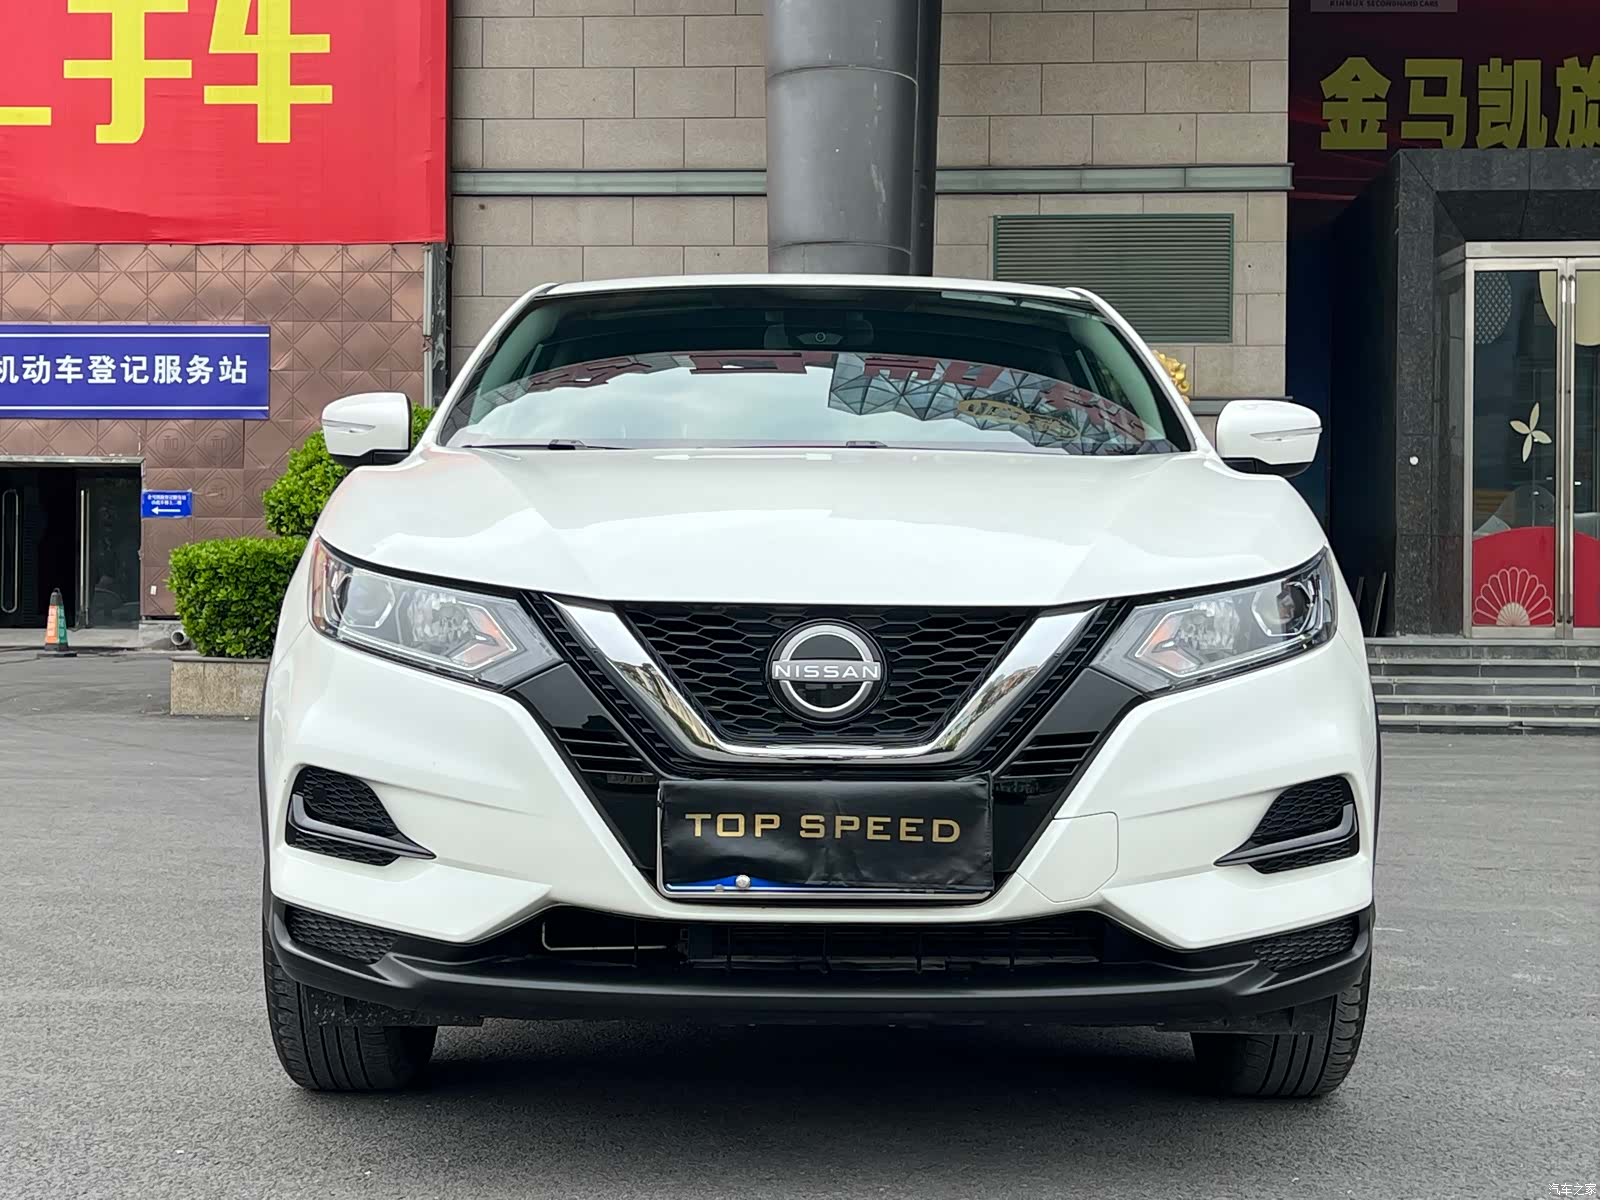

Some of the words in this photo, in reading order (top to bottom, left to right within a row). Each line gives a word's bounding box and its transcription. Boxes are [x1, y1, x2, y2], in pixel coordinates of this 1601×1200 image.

[0, 354, 248, 385] 机动车登记服务站
[774, 663, 880, 680] NISSAN
[685, 813, 781, 838] TOP
[799, 814, 961, 843] SPEED
